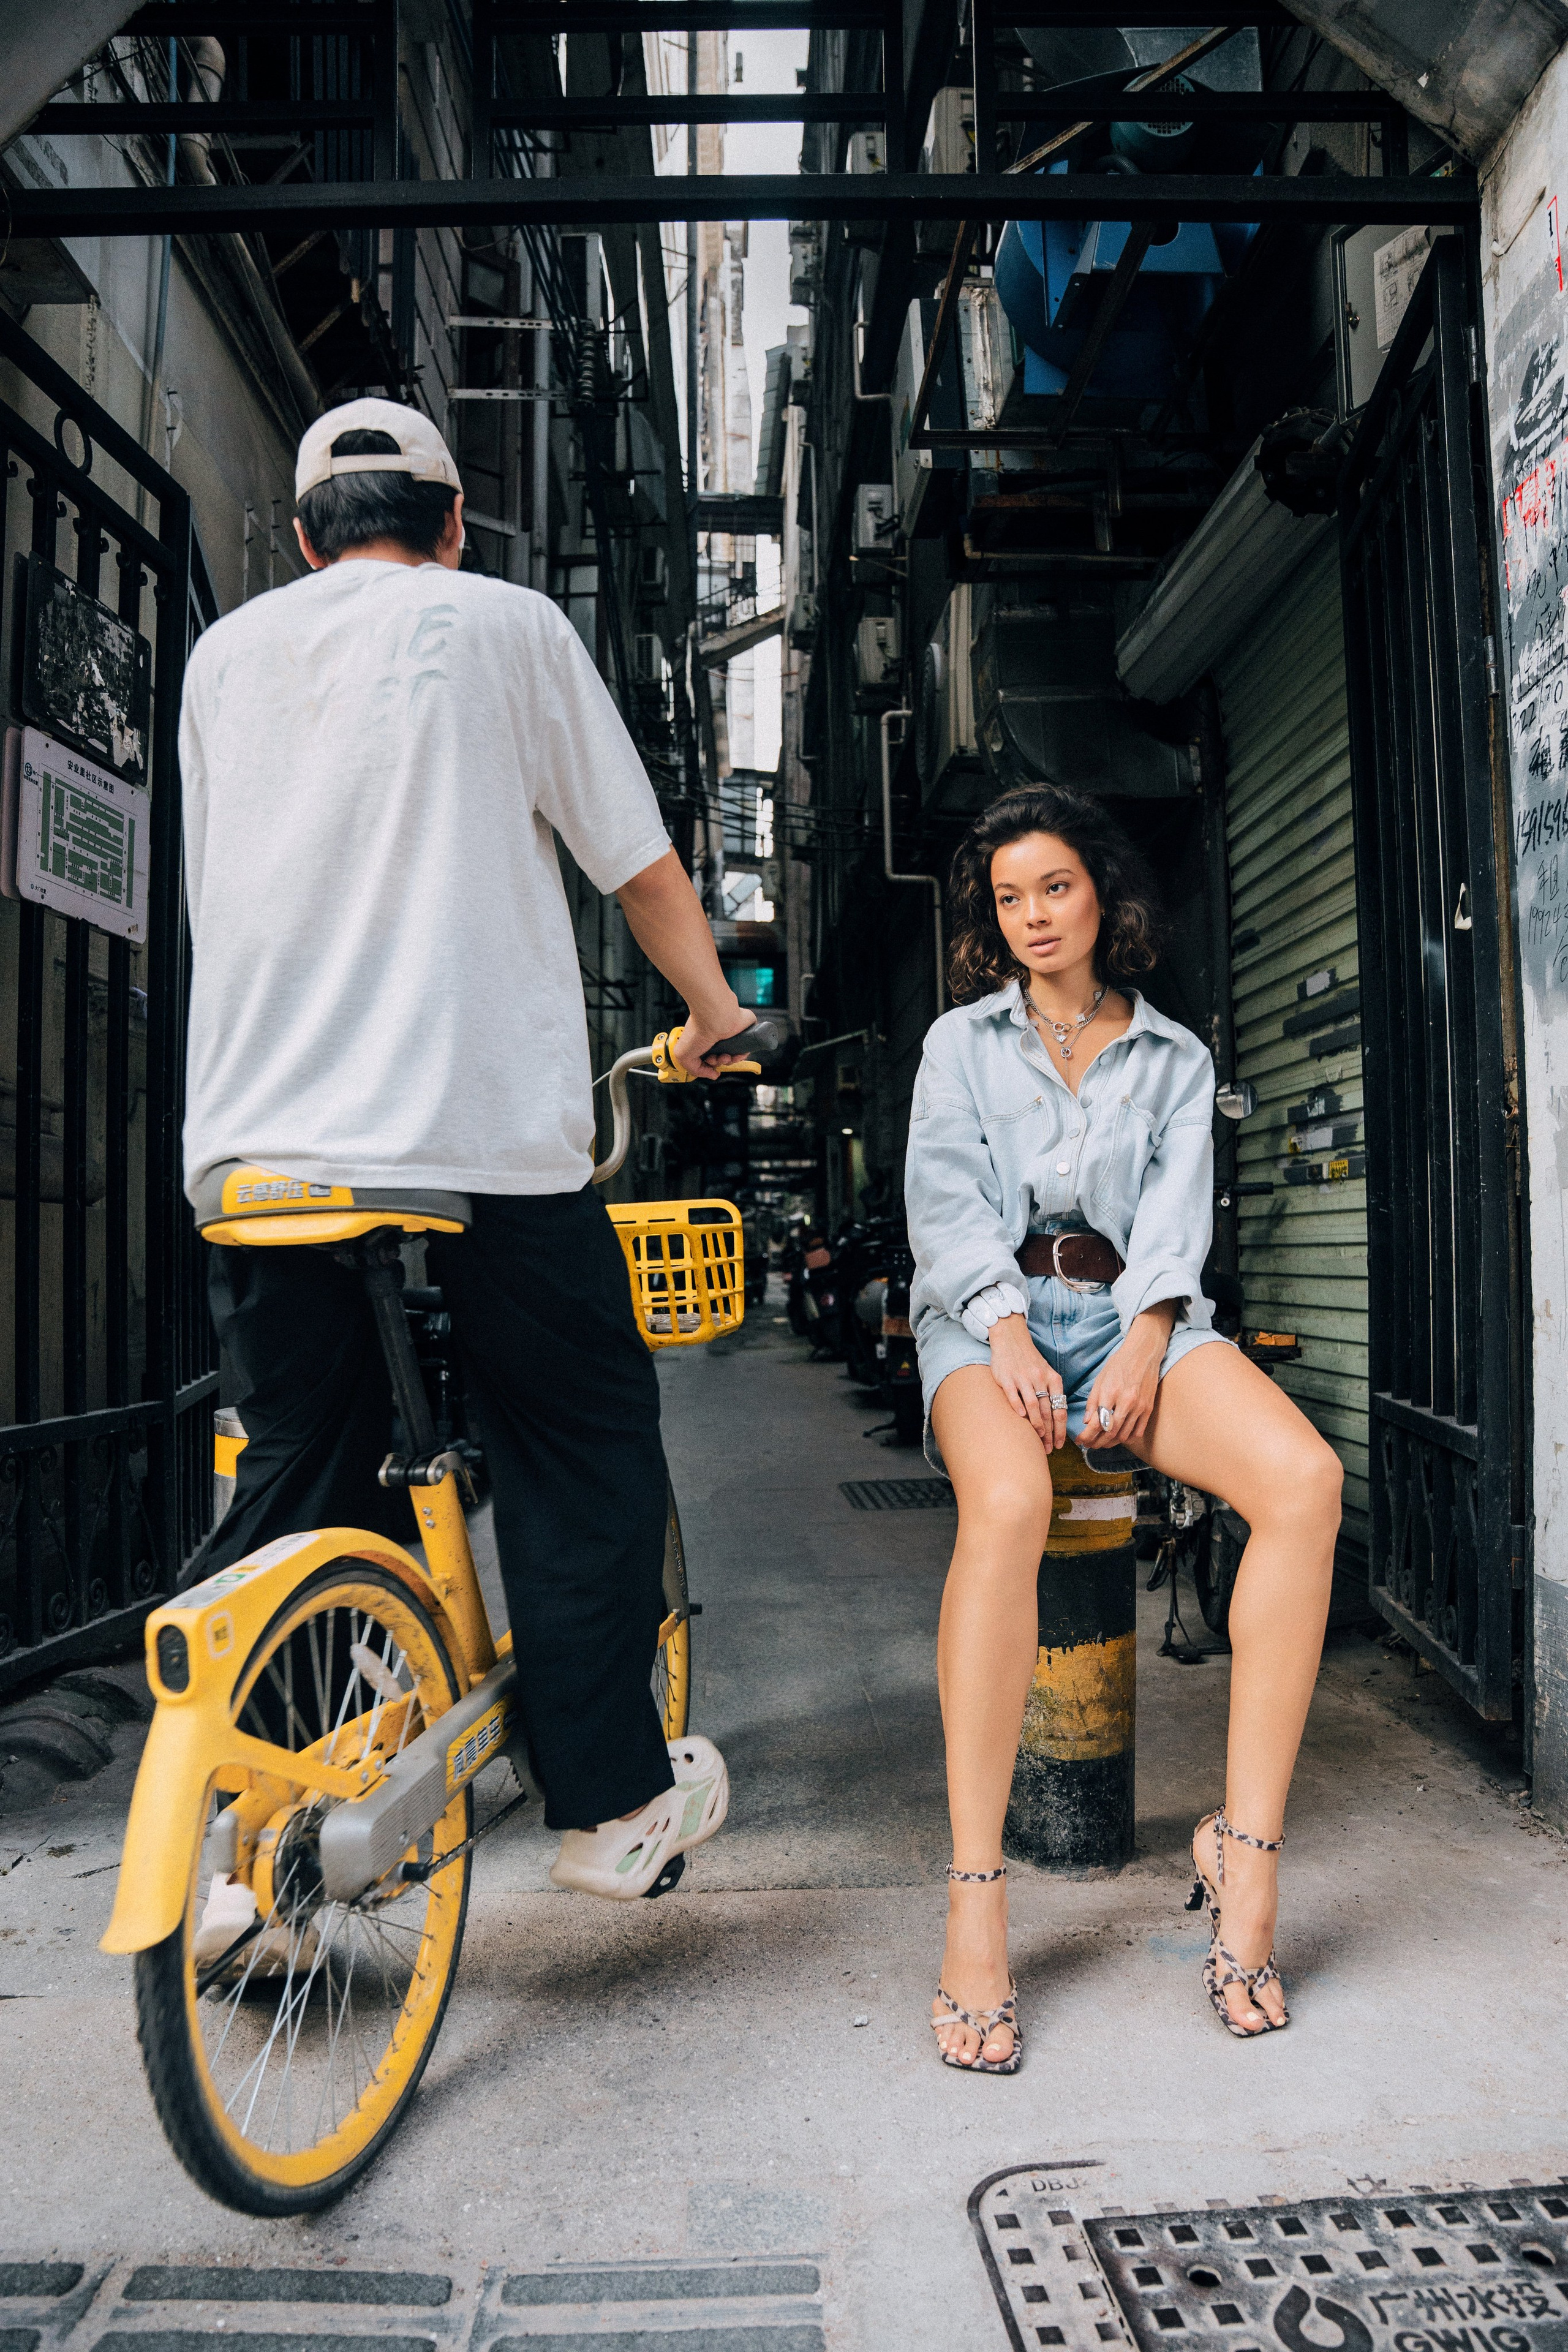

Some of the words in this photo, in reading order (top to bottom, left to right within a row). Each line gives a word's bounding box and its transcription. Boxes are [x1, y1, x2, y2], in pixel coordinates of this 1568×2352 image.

[67, 760, 115, 794] 安业里社区示意图
[1368, 2283, 1561, 2326] 广州水投
[1393, 2327, 1531, 2352] GWIG
